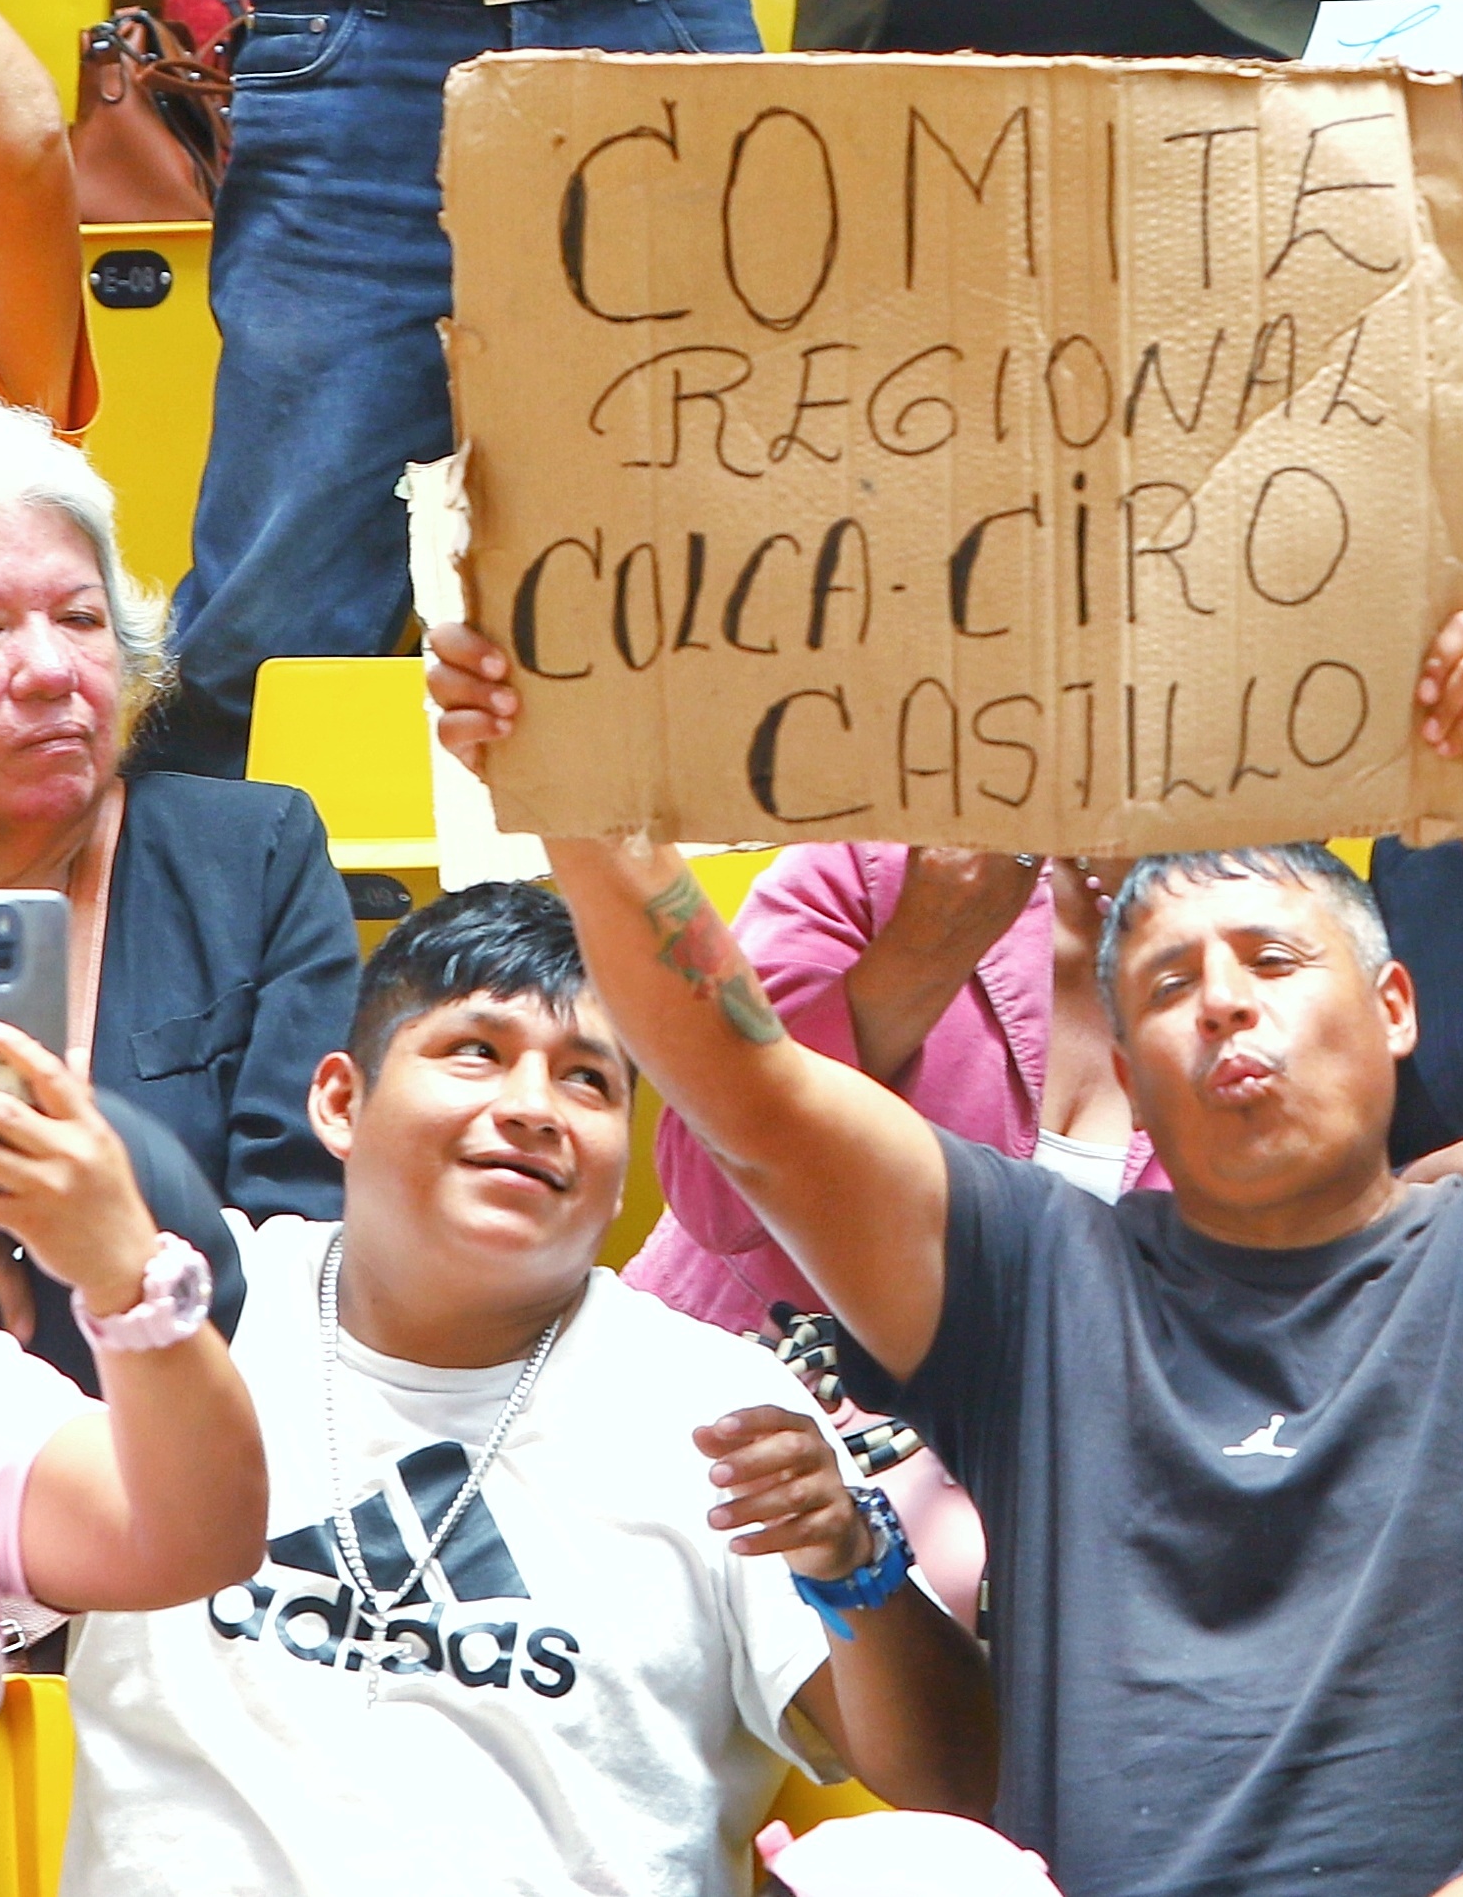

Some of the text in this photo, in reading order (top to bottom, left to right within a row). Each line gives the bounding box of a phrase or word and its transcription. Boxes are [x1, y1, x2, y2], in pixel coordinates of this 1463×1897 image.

[558, 99, 1402, 332] COMITE
[588, 313, 1385, 479] REGIONAL
[747, 660, 1369, 825] CASTILLO
[207, 1576, 581, 1700] adidas
